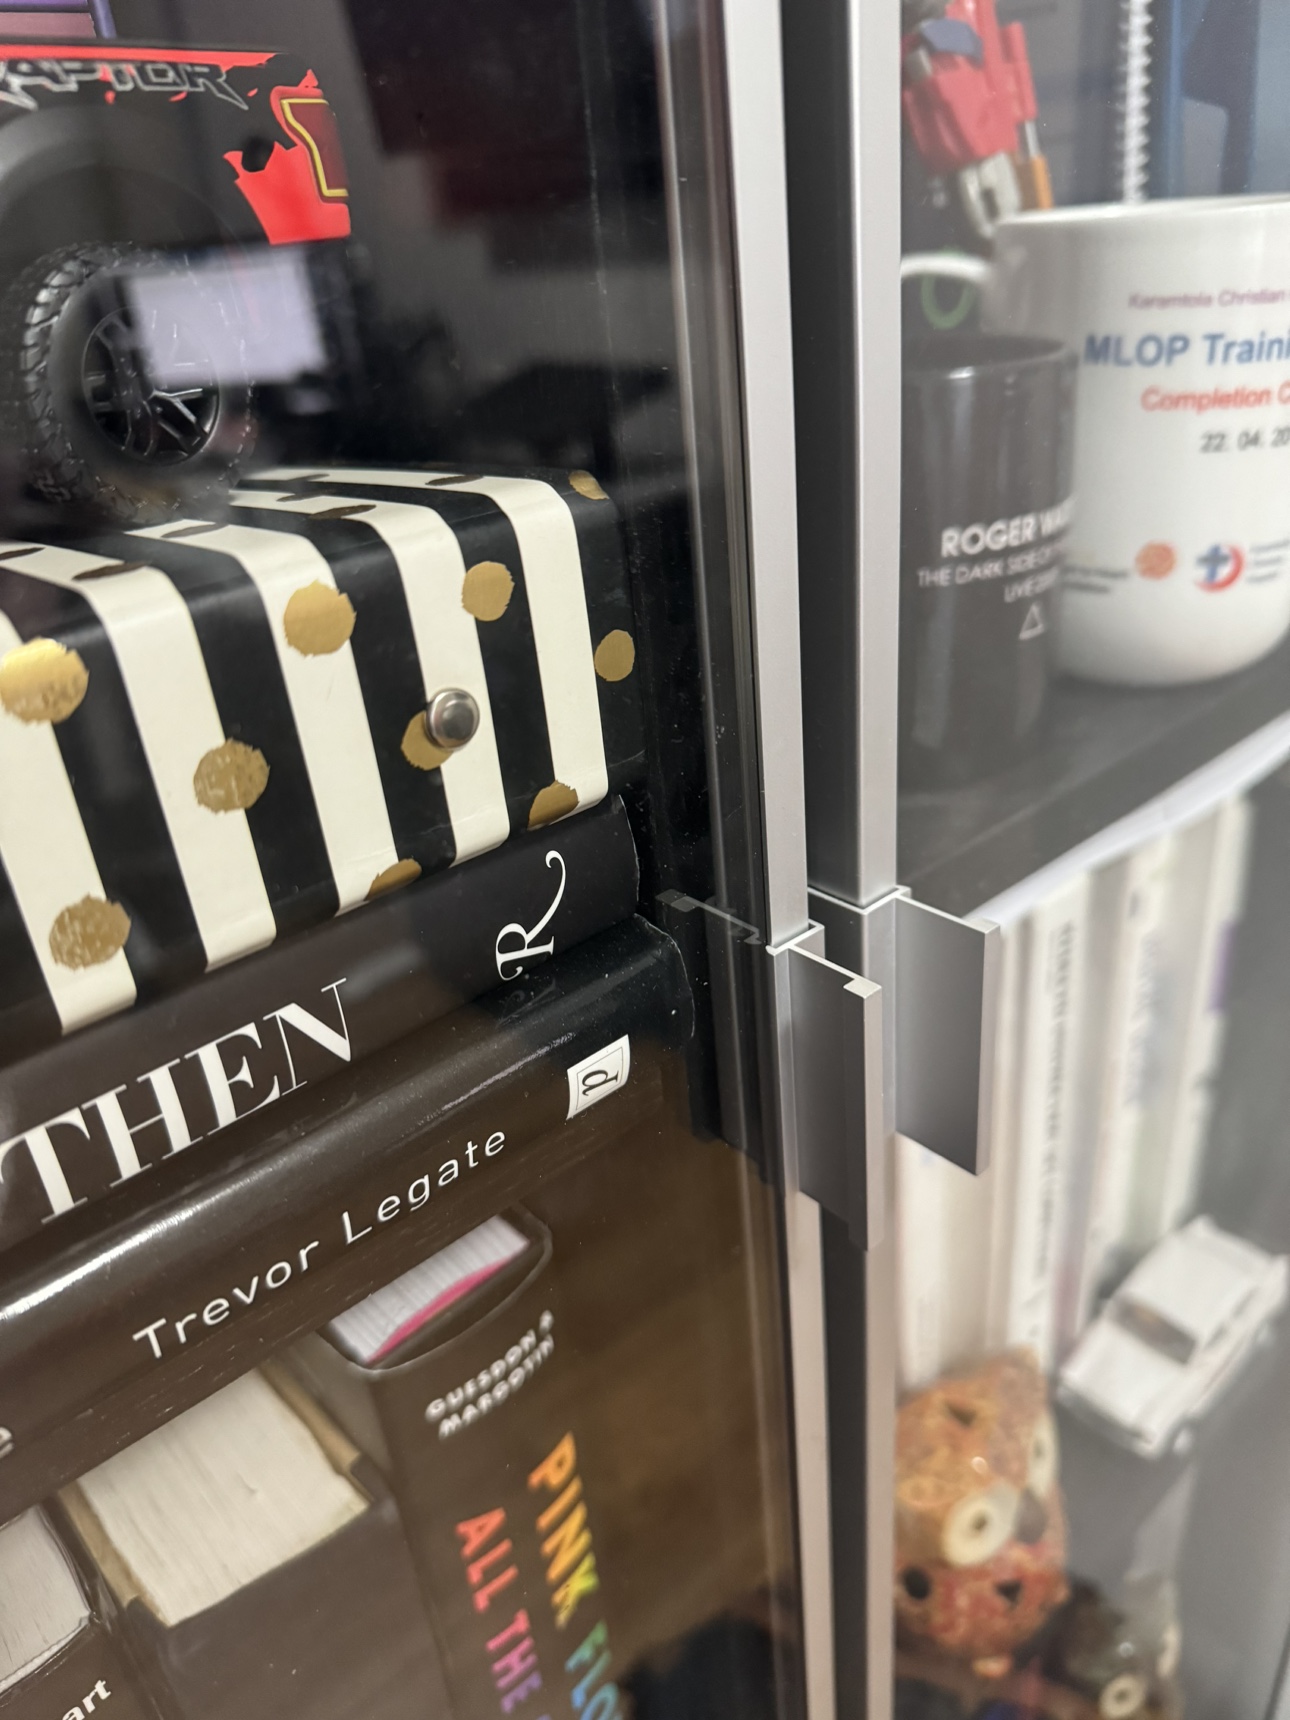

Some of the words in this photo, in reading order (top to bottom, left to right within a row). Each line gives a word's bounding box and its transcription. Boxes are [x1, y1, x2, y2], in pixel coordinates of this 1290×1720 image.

[1083, 332, 1191, 367] MLOP
[1140, 384, 1272, 416] Completion
[917, 563, 951, 587] THE
[955, 558, 1004, 584] DARK
[1007, 551, 1035, 576] SIDE
[942, 516, 1035, 558] ROGER
[0, 978, 352, 1224] THEN
[133, 1242, 319, 1360] Trevor
[342, 1129, 507, 1246] Legate
[438, 1332, 555, 1440] MARGOTIN
[455, 1506, 518, 1613] ALL
[527, 1430, 598, 1630] PINK
[486, 1607, 543, 1715] THE
[564, 1617, 622, 1720] FLO
